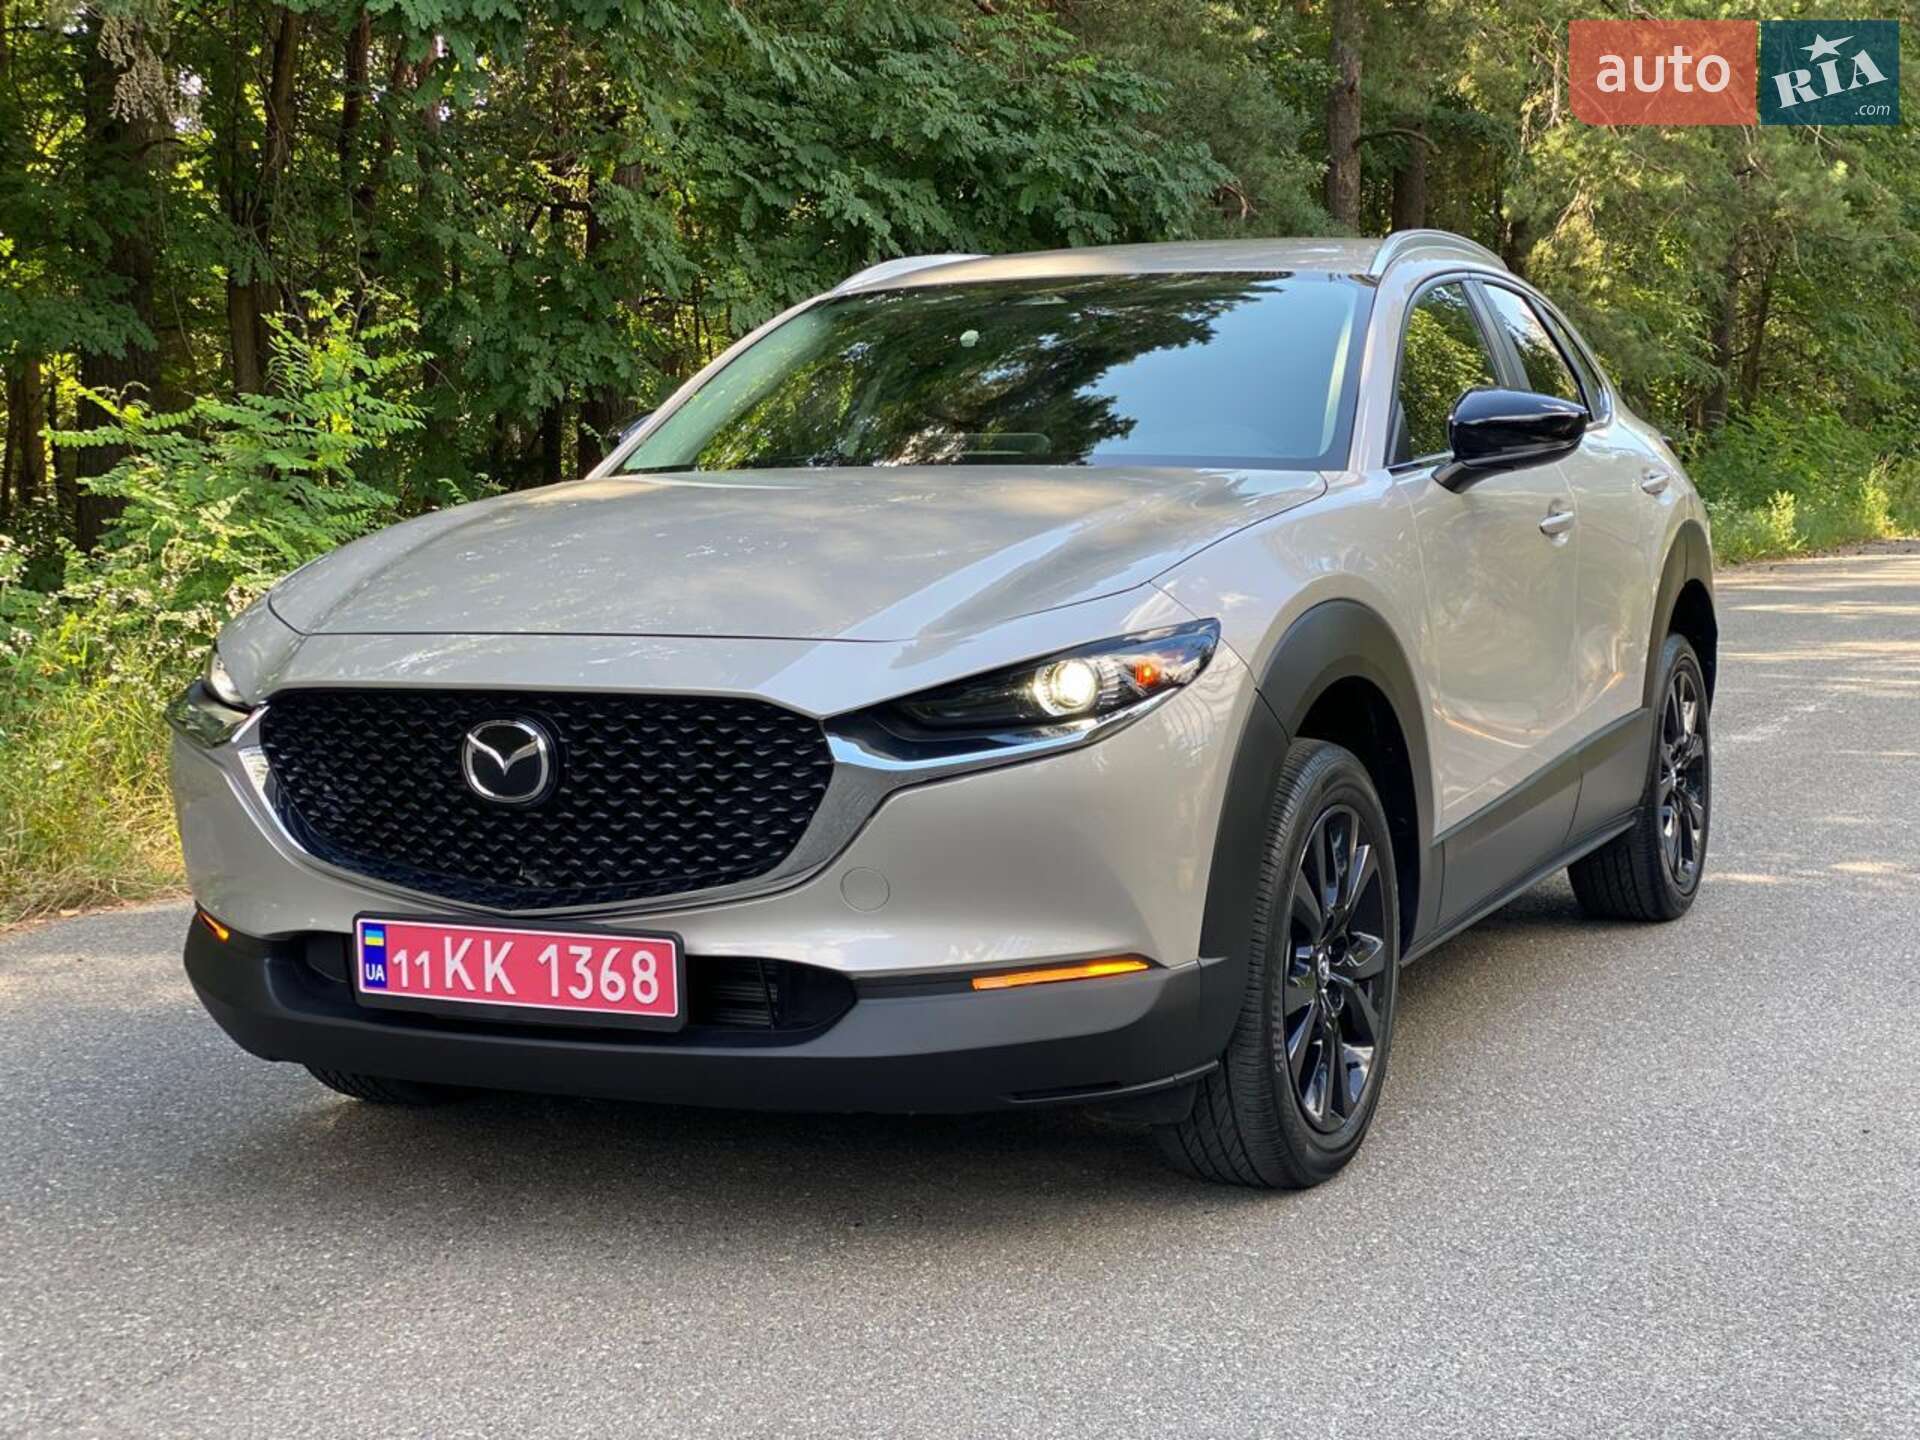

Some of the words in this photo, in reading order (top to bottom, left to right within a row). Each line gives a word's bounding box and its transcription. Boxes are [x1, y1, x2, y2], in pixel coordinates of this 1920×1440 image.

[365, 963, 386, 982] UA
[392, 936, 517, 995] 11KK
[537, 944, 659, 1005] 1368
